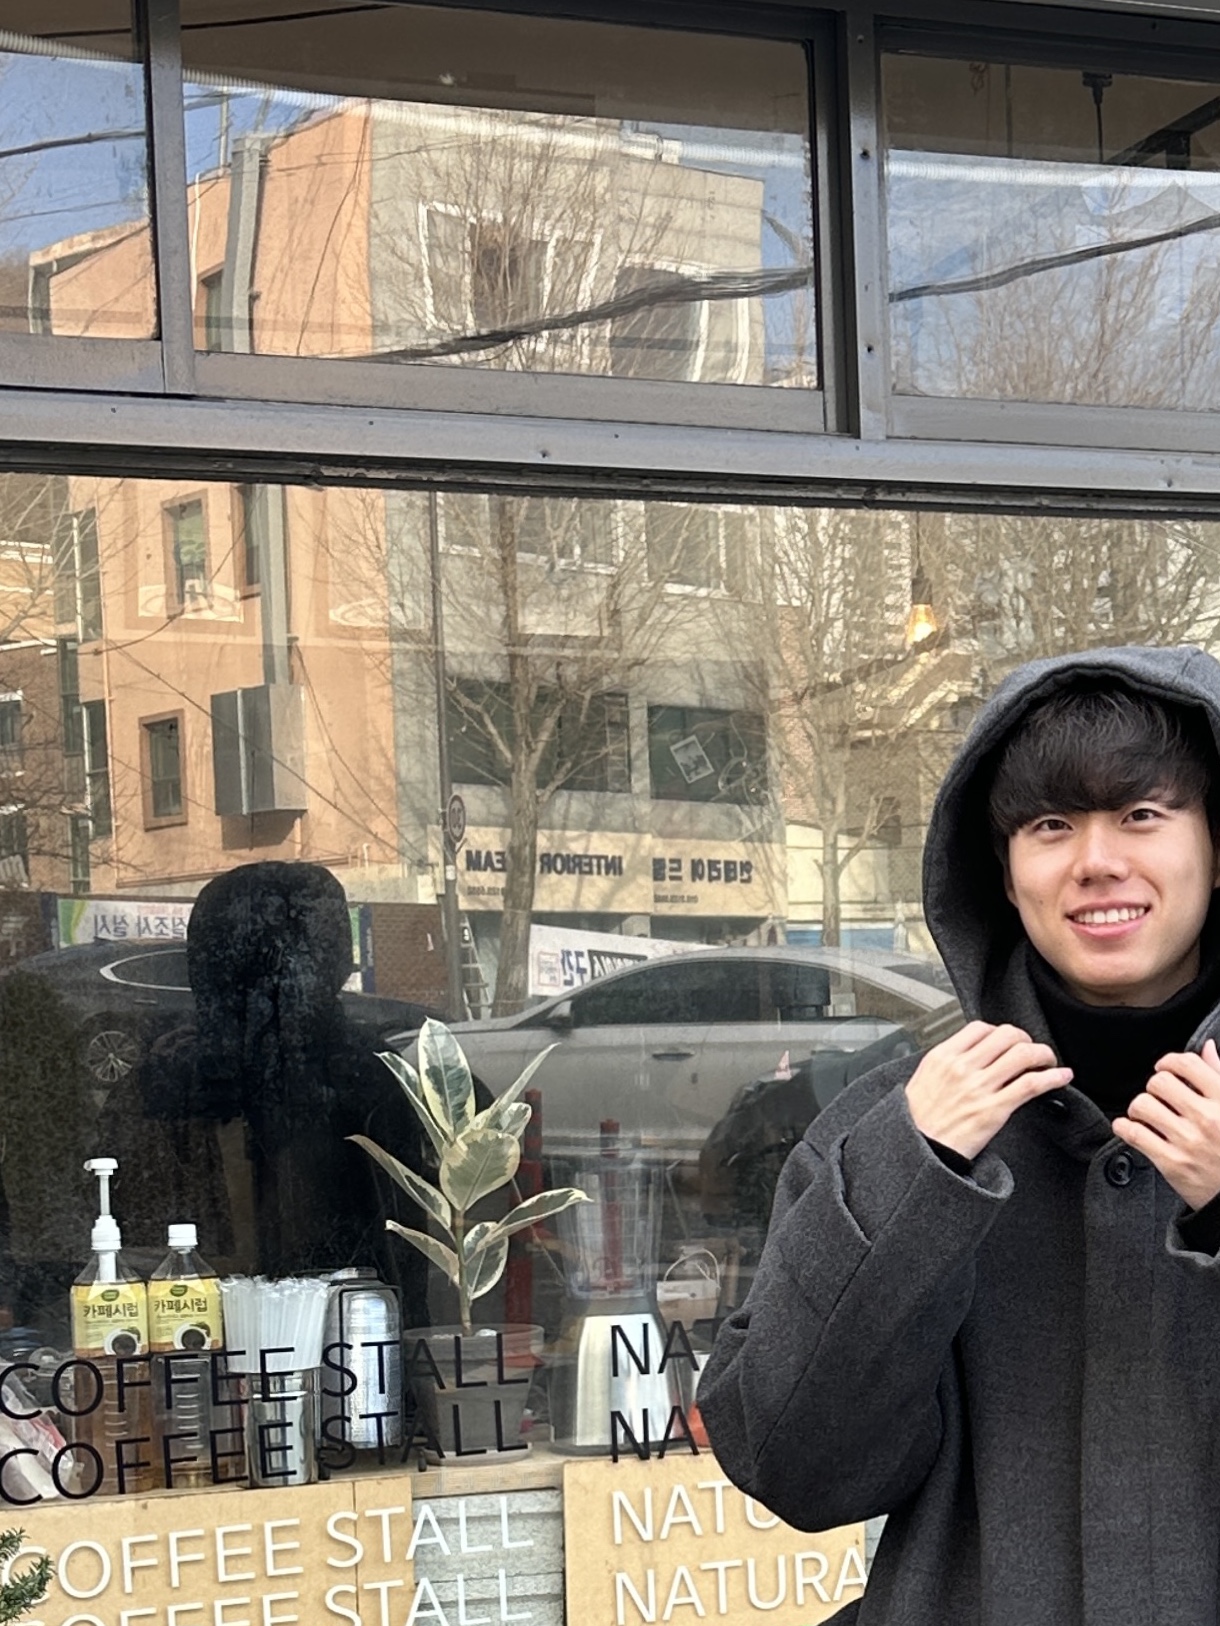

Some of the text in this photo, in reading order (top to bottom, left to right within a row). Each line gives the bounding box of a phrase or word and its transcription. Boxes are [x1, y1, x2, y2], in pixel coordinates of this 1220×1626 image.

[83, 1303, 139, 1319] 카페시럽
[153, 1298, 208, 1313] 카페시럽
[0, 1347, 296, 1420] COFFEE
[321, 1332, 529, 1398] STALL
[0, 1400, 700, 1506] COFFEE STALL NA
[326, 1496, 534, 1569] STALL
[612, 1480, 778, 1545] NATU
[614, 1547, 868, 1626] NATURA
